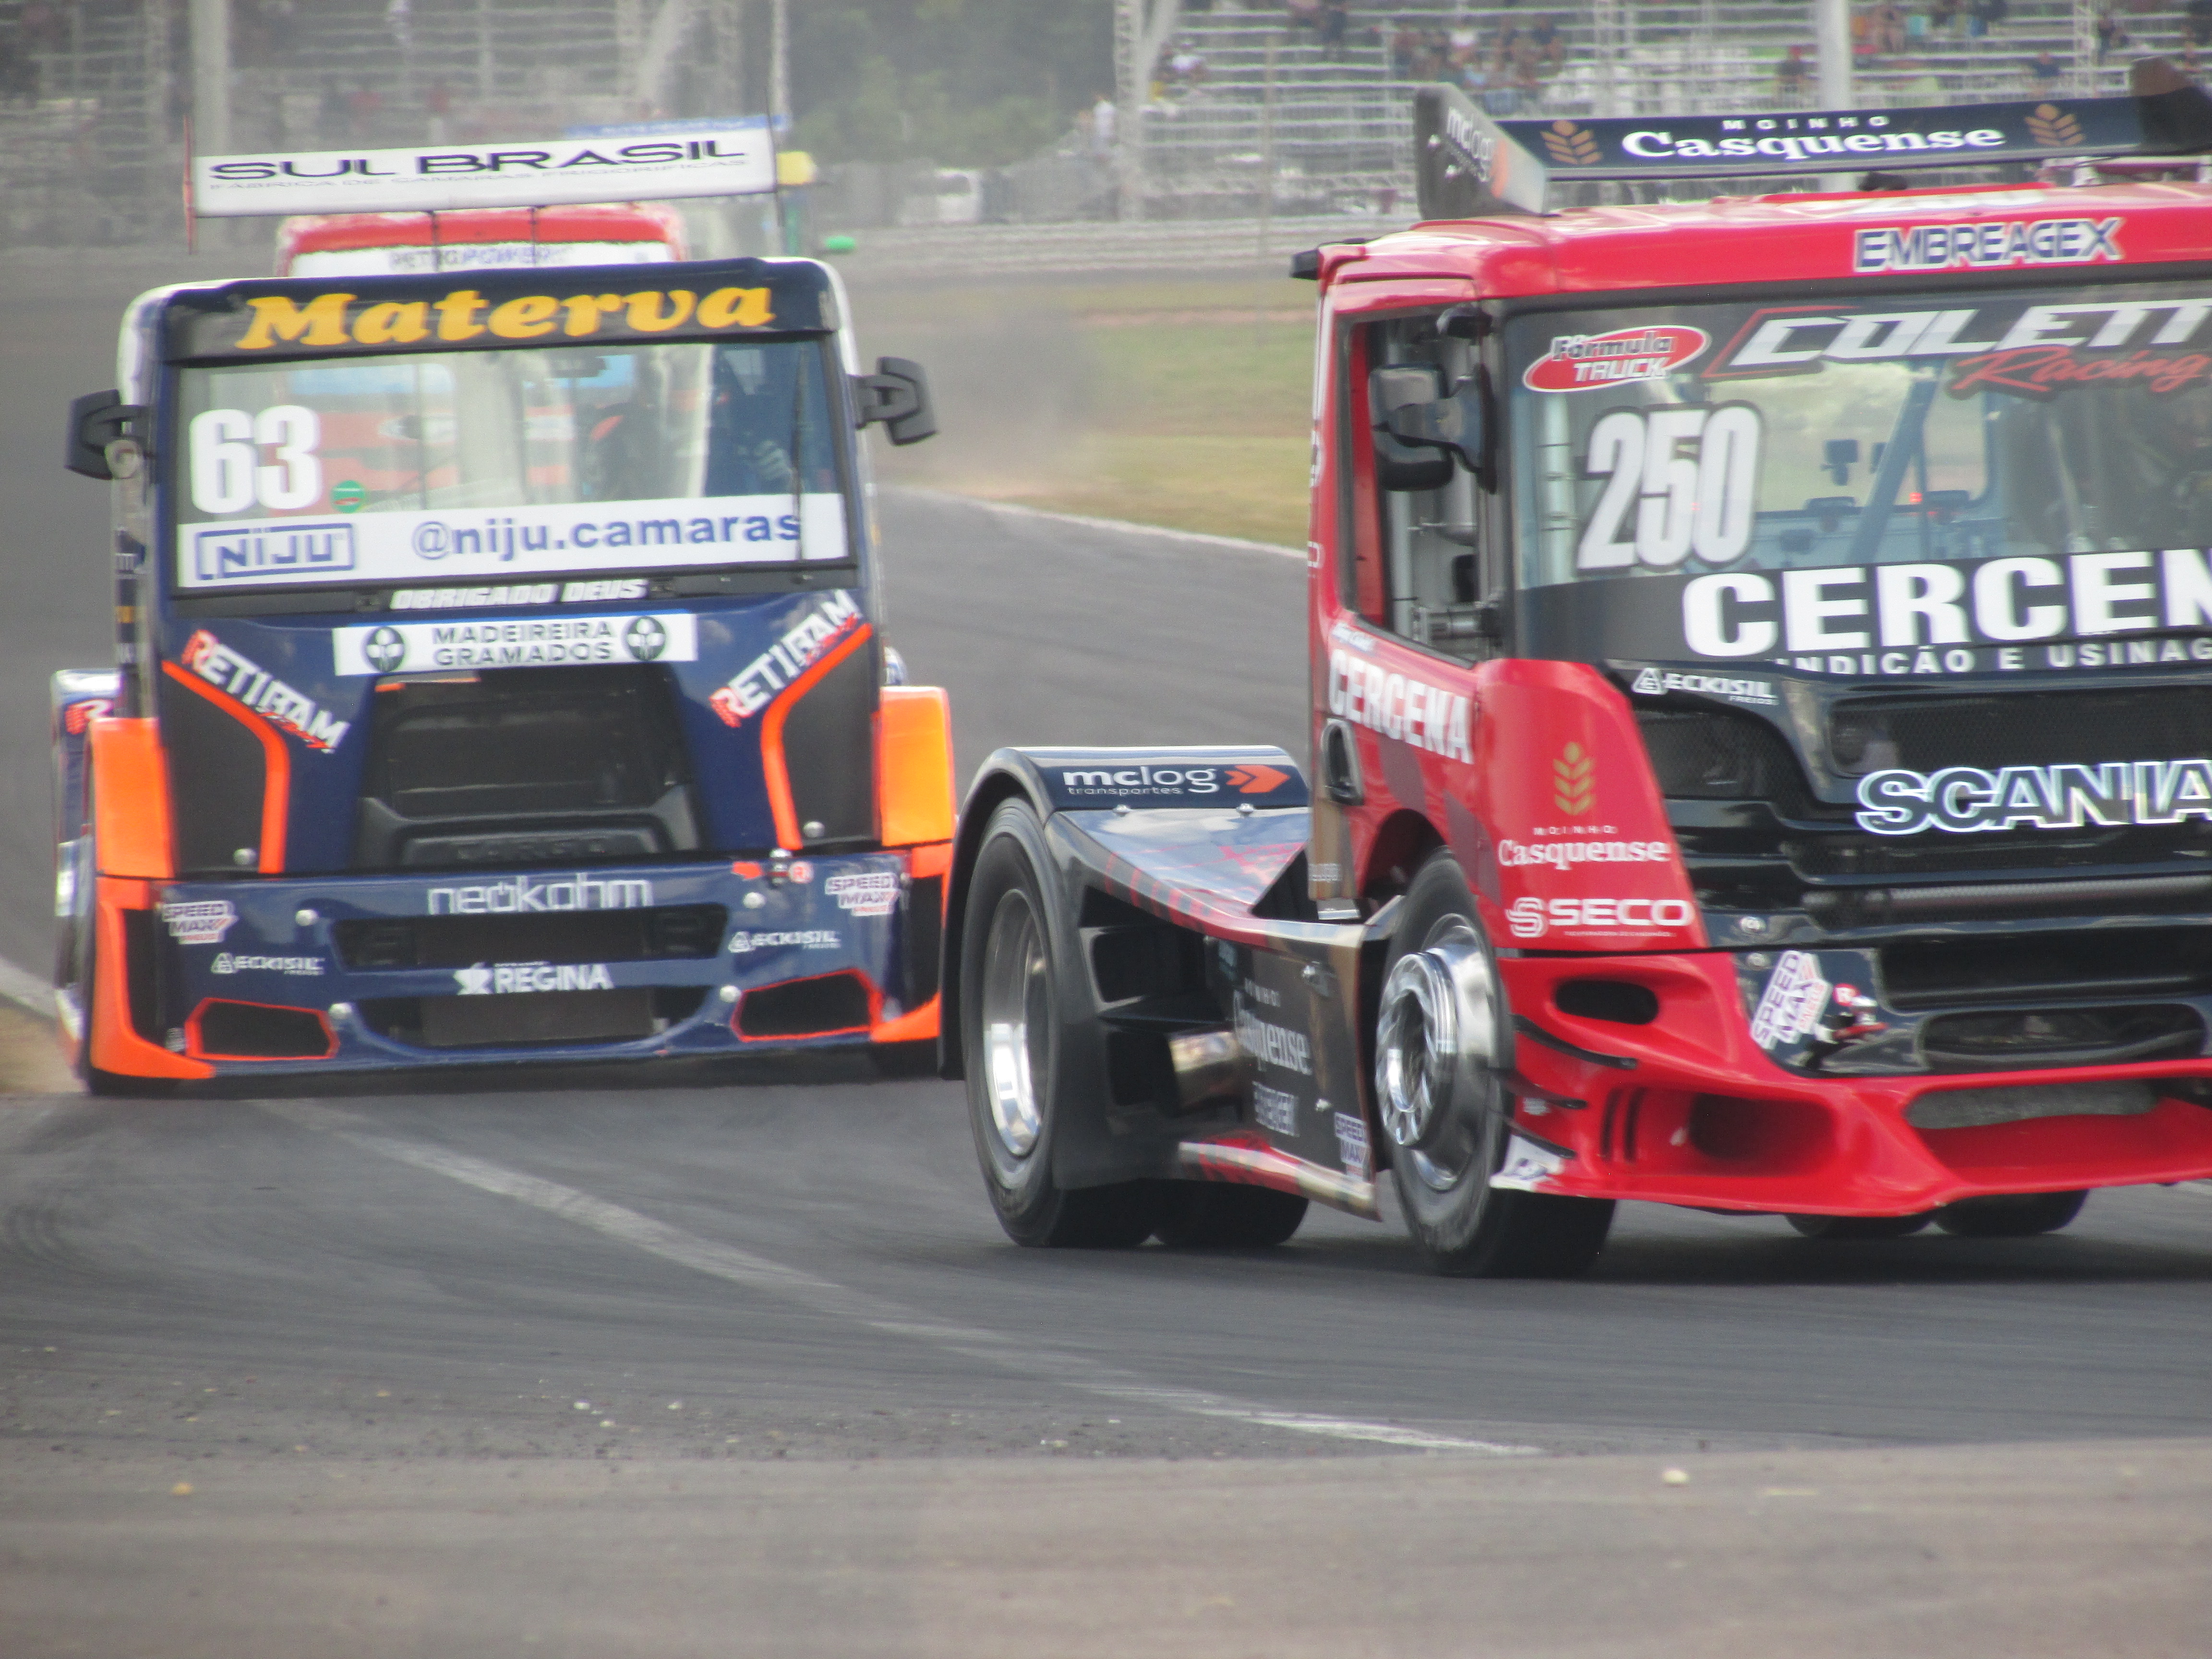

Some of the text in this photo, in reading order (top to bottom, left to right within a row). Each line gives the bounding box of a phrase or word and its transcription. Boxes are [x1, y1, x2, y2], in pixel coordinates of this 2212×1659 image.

[1721, 115, 1890, 131] MOINHO
[209, 140, 745, 179] SUL BRASIL
[1622, 129, 2006, 160] Casquense
[1854, 217, 2127, 273] EMBREAGEX
[235, 287, 777, 350] Materva
[1573, 357, 1671, 382] TRUCK
[1951, 346, 2211, 393] Racing
[189, 404, 322, 514] 63
[1578, 402, 1761, 569] 250
[411, 514, 801, 562] @niju.camaras
[389, 579, 649, 610] OBRIGADO DEUS
[433, 621, 616, 645] MADEIREIRA
[434, 642, 613, 666] GRAMADOS
[1769, 646, 1976, 674] NDIÇÃO
[1999, 648, 2026, 670] E
[1662, 673, 1778, 698] ECKISIL
[1329, 649, 1475, 765] CERCENA
[1063, 766, 1220, 793] mclog
[1068, 786, 1184, 796] transportes
[1856, 760, 2212, 835] SCANIA
[1533, 825, 1619, 836] MOINHO
[1498, 839, 1672, 871] Casquense
[427, 872, 654, 915] neokohm
[826, 874, 896, 893] SPEED
[839, 891, 888, 906] MAX
[162, 902, 228, 921] SPEED
[170, 918, 222, 935] MAX
[1549, 898, 1693, 926] SECO
[493, 963, 615, 994] REGINA
[1753, 951, 1802, 1044] SPEED
